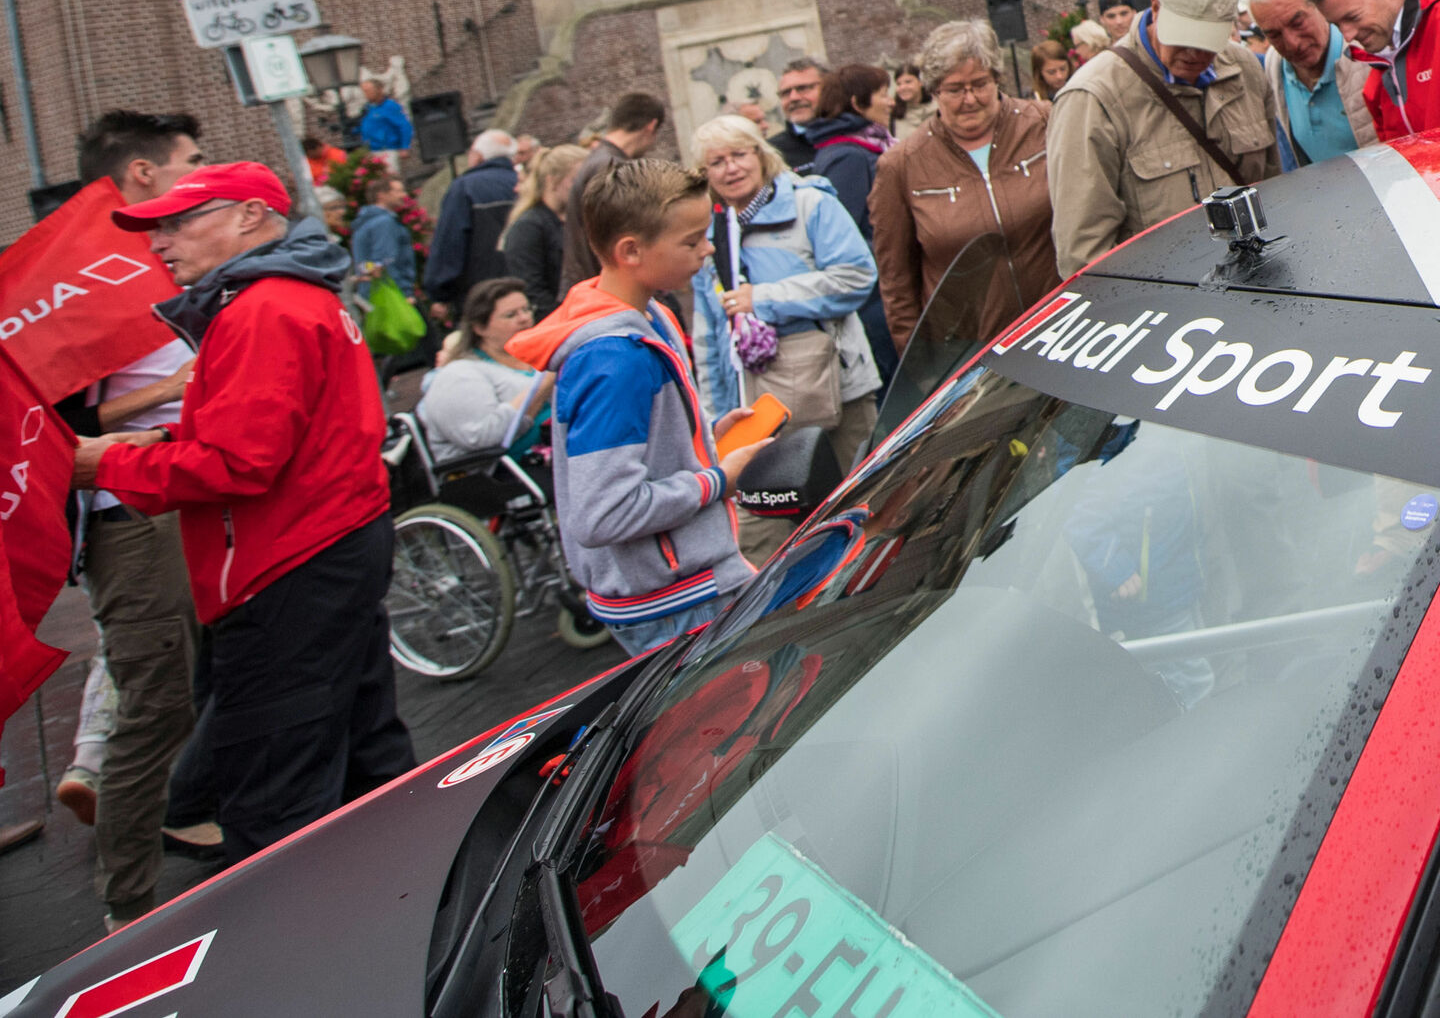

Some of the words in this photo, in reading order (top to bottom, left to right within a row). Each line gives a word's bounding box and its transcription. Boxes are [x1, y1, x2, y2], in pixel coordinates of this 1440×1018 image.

[1022, 301, 1168, 373] Audi
[1131, 317, 1432, 428] Sport
[742, 491, 761, 503] Audi
[762, 490, 798, 507] Sport
